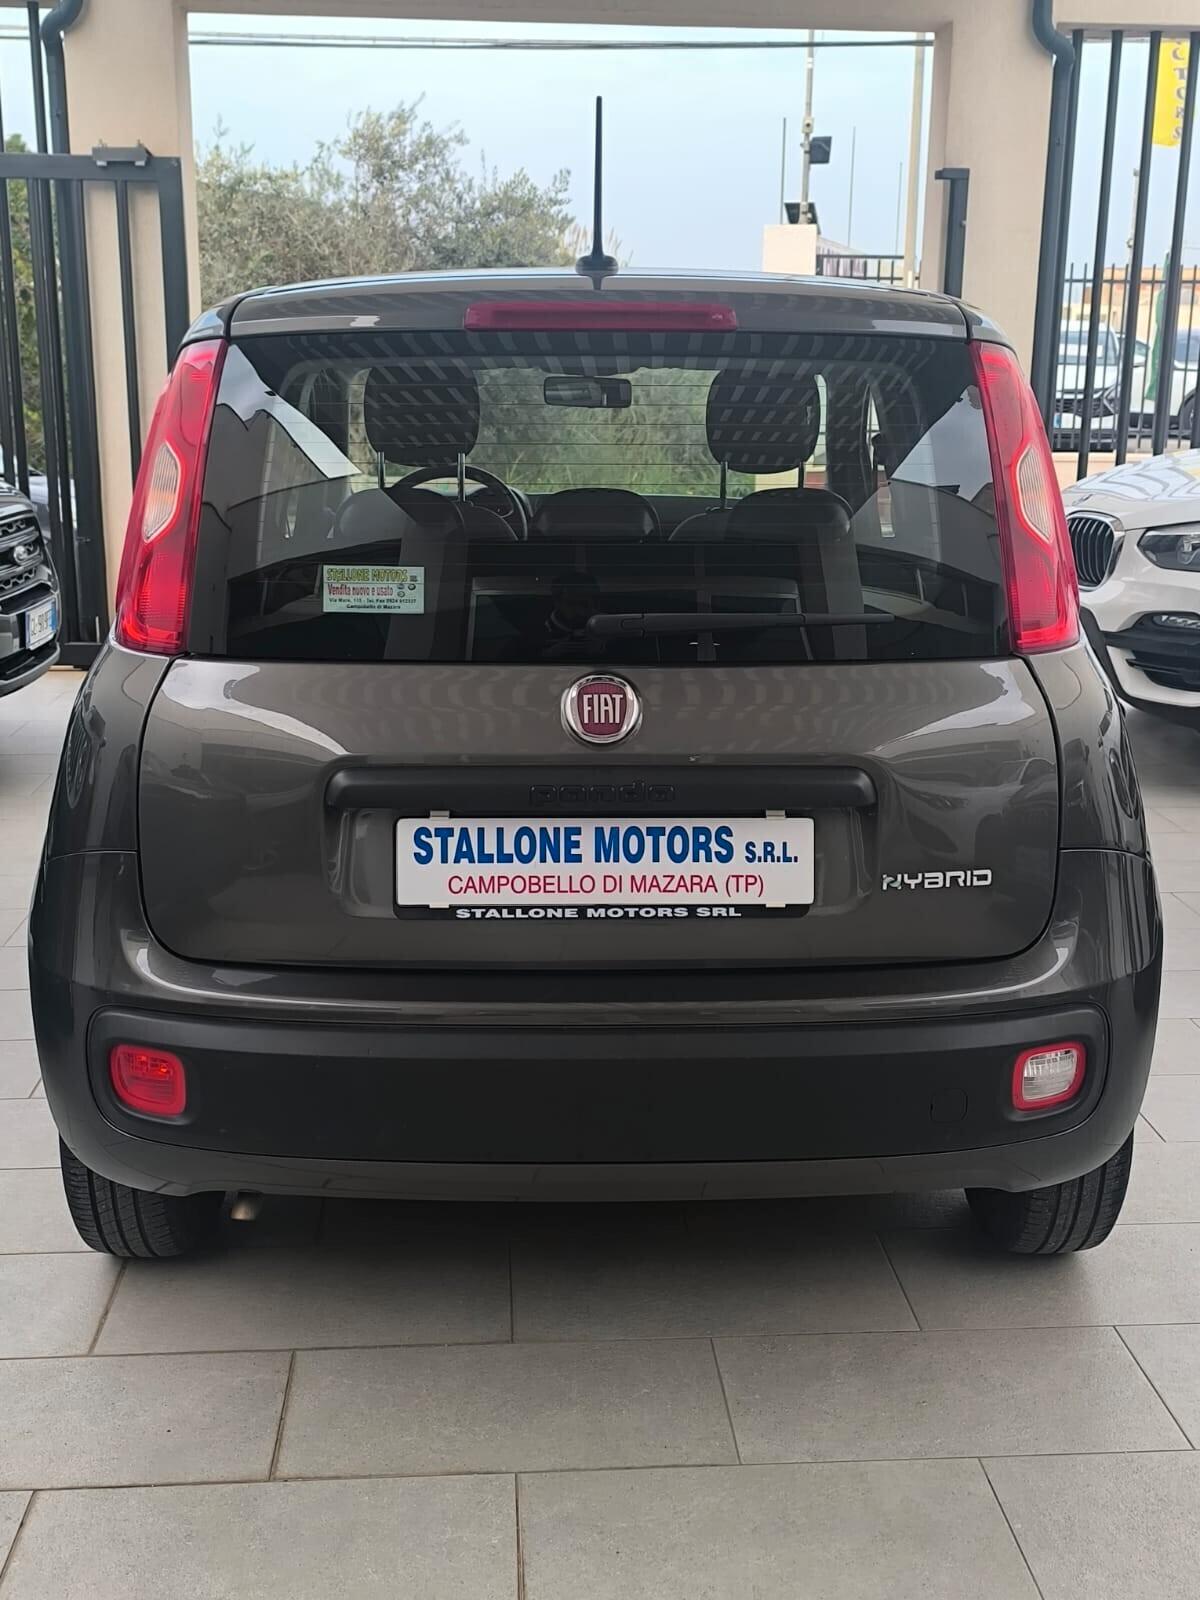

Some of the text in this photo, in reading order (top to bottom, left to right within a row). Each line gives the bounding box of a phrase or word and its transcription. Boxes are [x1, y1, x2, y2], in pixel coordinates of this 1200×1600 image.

[327, 568, 370, 581] STALLONE
[371, 568, 407, 582] MOTORS
[327, 583, 393, 596] Vendita nuovo e usato
[583, 693, 624, 724] FIAT
[412, 825, 799, 865] STALLONE MOTORS S.R.L.
[447, 874, 764, 897] CAMPOBELLO DI MAZARA (TP)
[881, 868, 993, 891] HYBRID
[456, 906, 742, 919] STALLONE MOTORS SRL
